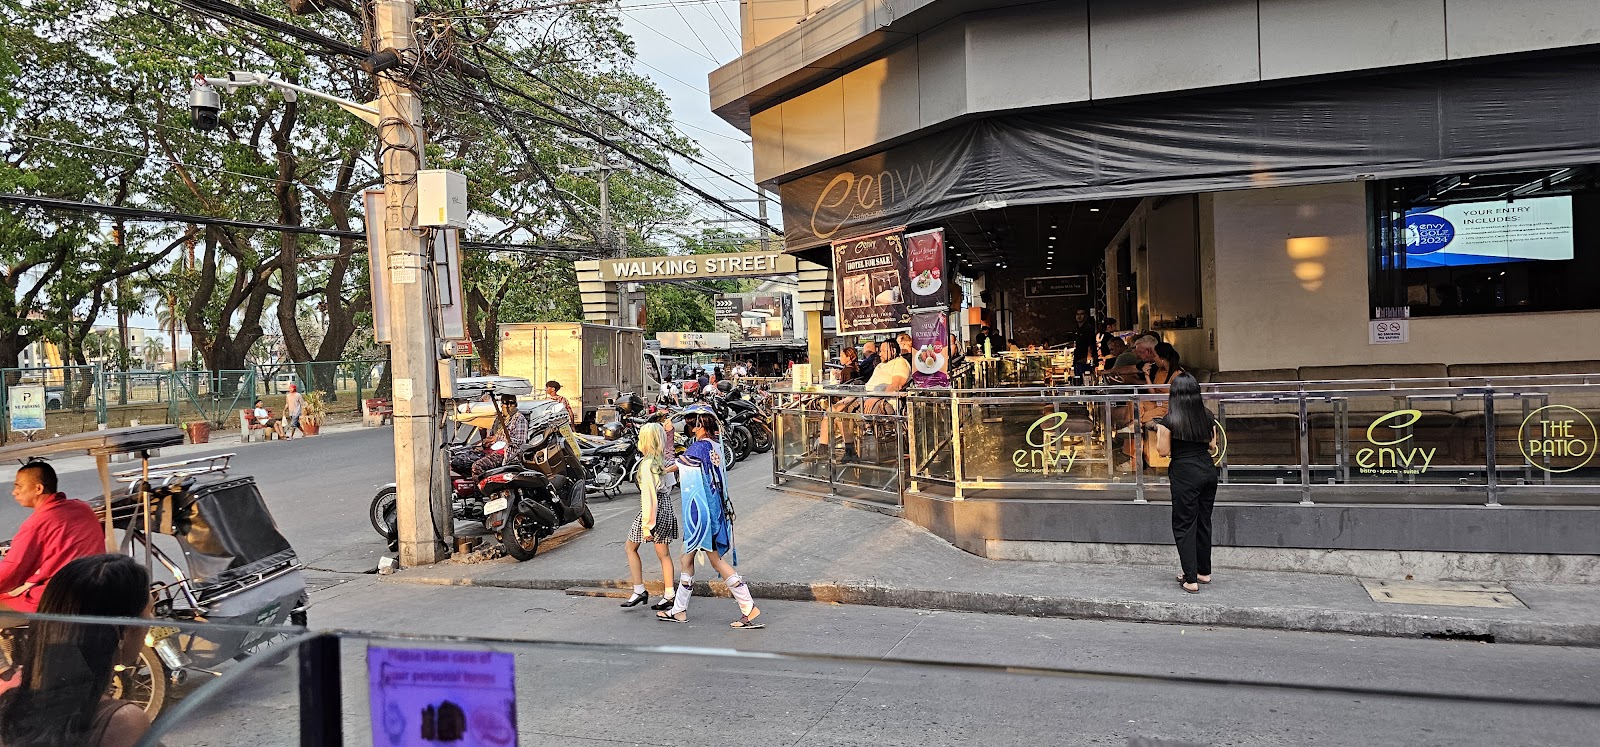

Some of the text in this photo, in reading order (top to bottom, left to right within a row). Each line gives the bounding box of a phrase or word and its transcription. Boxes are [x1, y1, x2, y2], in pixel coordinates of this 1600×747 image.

[1463, 206, 1531, 216] YOUR ENTRY
[1463, 216, 1521, 225] INCLUDES:
[612, 254, 779, 277] WALKING STREET
[847, 256, 891, 270] HOTEL FOR SALE
[1540, 420, 1574, 438] THE
[1529, 439, 1588, 456] PATIO
[1012, 450, 1078, 472] envy
[1356, 448, 1436, 474] envy
